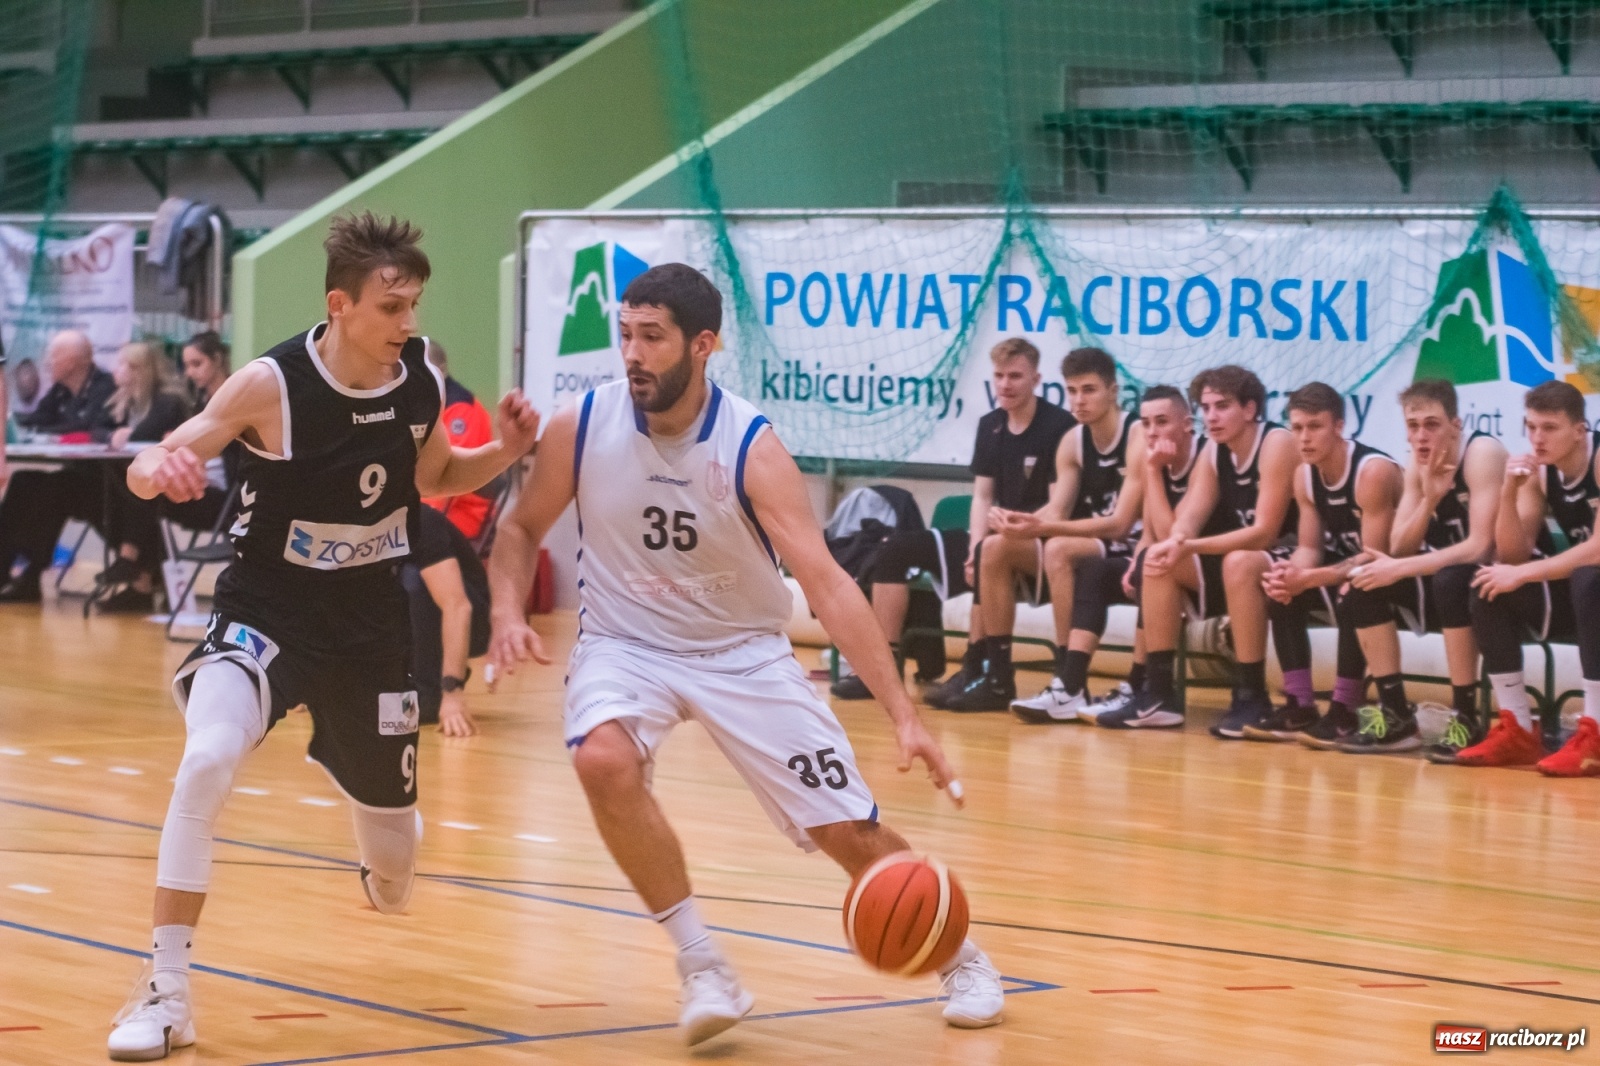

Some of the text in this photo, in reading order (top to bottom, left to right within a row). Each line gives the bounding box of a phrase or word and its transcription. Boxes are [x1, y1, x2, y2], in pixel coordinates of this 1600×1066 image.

[764, 271, 1368, 342] POWIAT RACIBORSKI
[760, 359, 963, 418] kibicujemy,
[352, 407, 396, 425] hummel
[359, 463, 388, 509] 9
[316, 525, 406, 564] ZOFSTAL
[642, 505, 699, 552] 35
[401, 744, 417, 795] 9
[787, 747, 849, 791] 35
